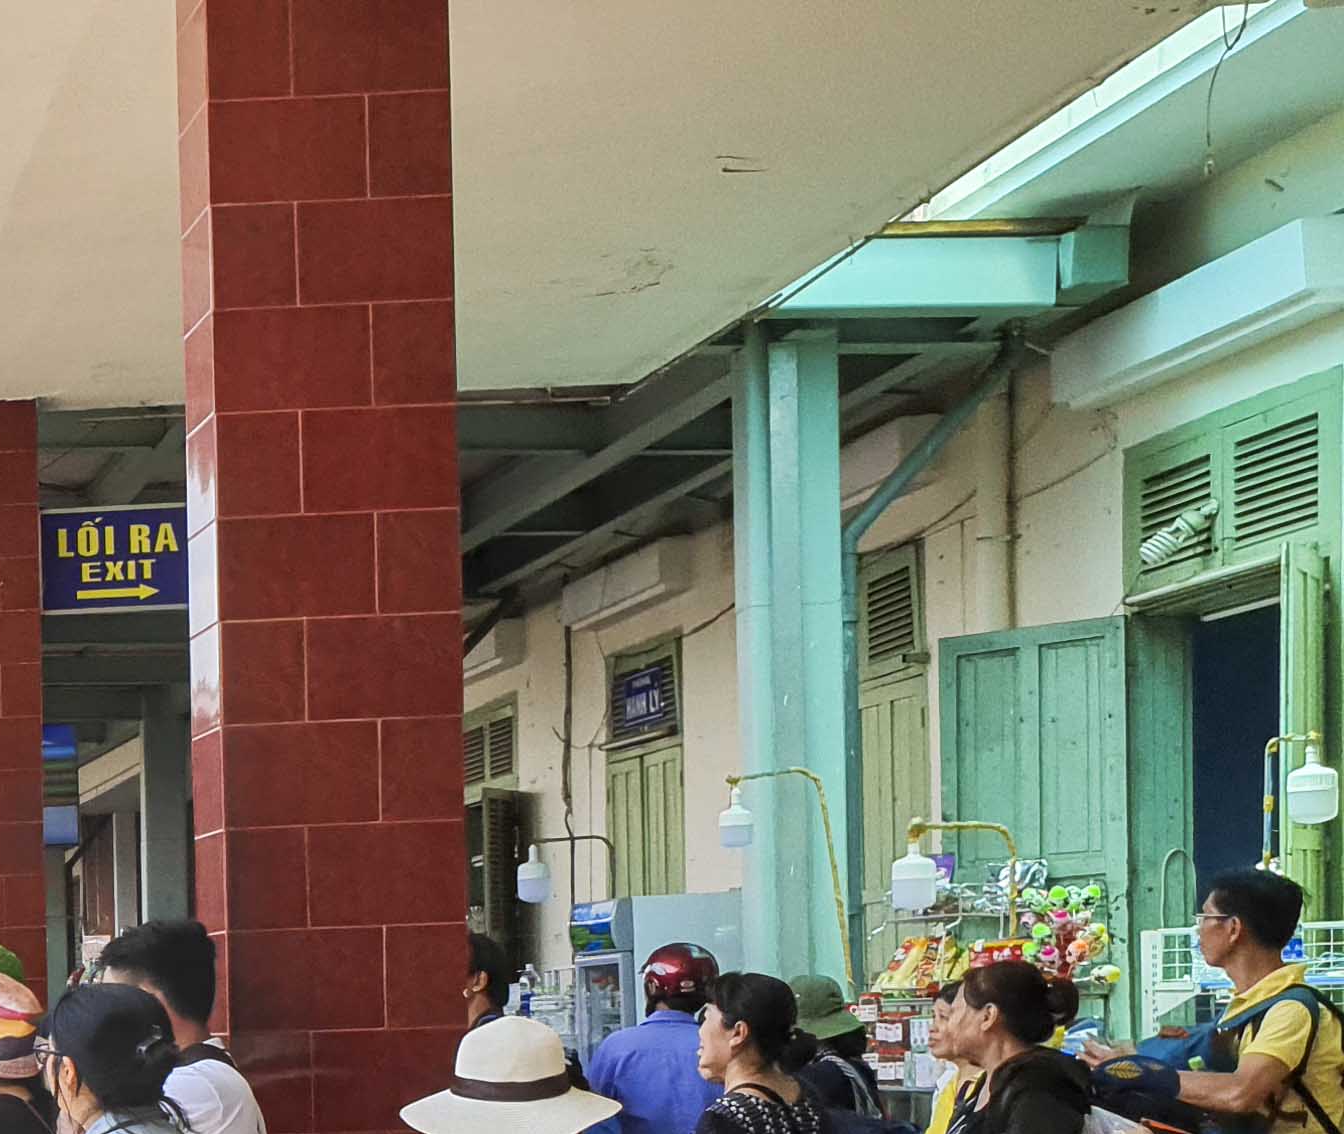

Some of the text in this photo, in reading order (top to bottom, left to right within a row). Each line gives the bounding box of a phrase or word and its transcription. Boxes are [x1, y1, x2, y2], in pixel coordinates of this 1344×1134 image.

[57, 516, 179, 558] LỐI RA
[81, 559, 156, 583] EXIT
